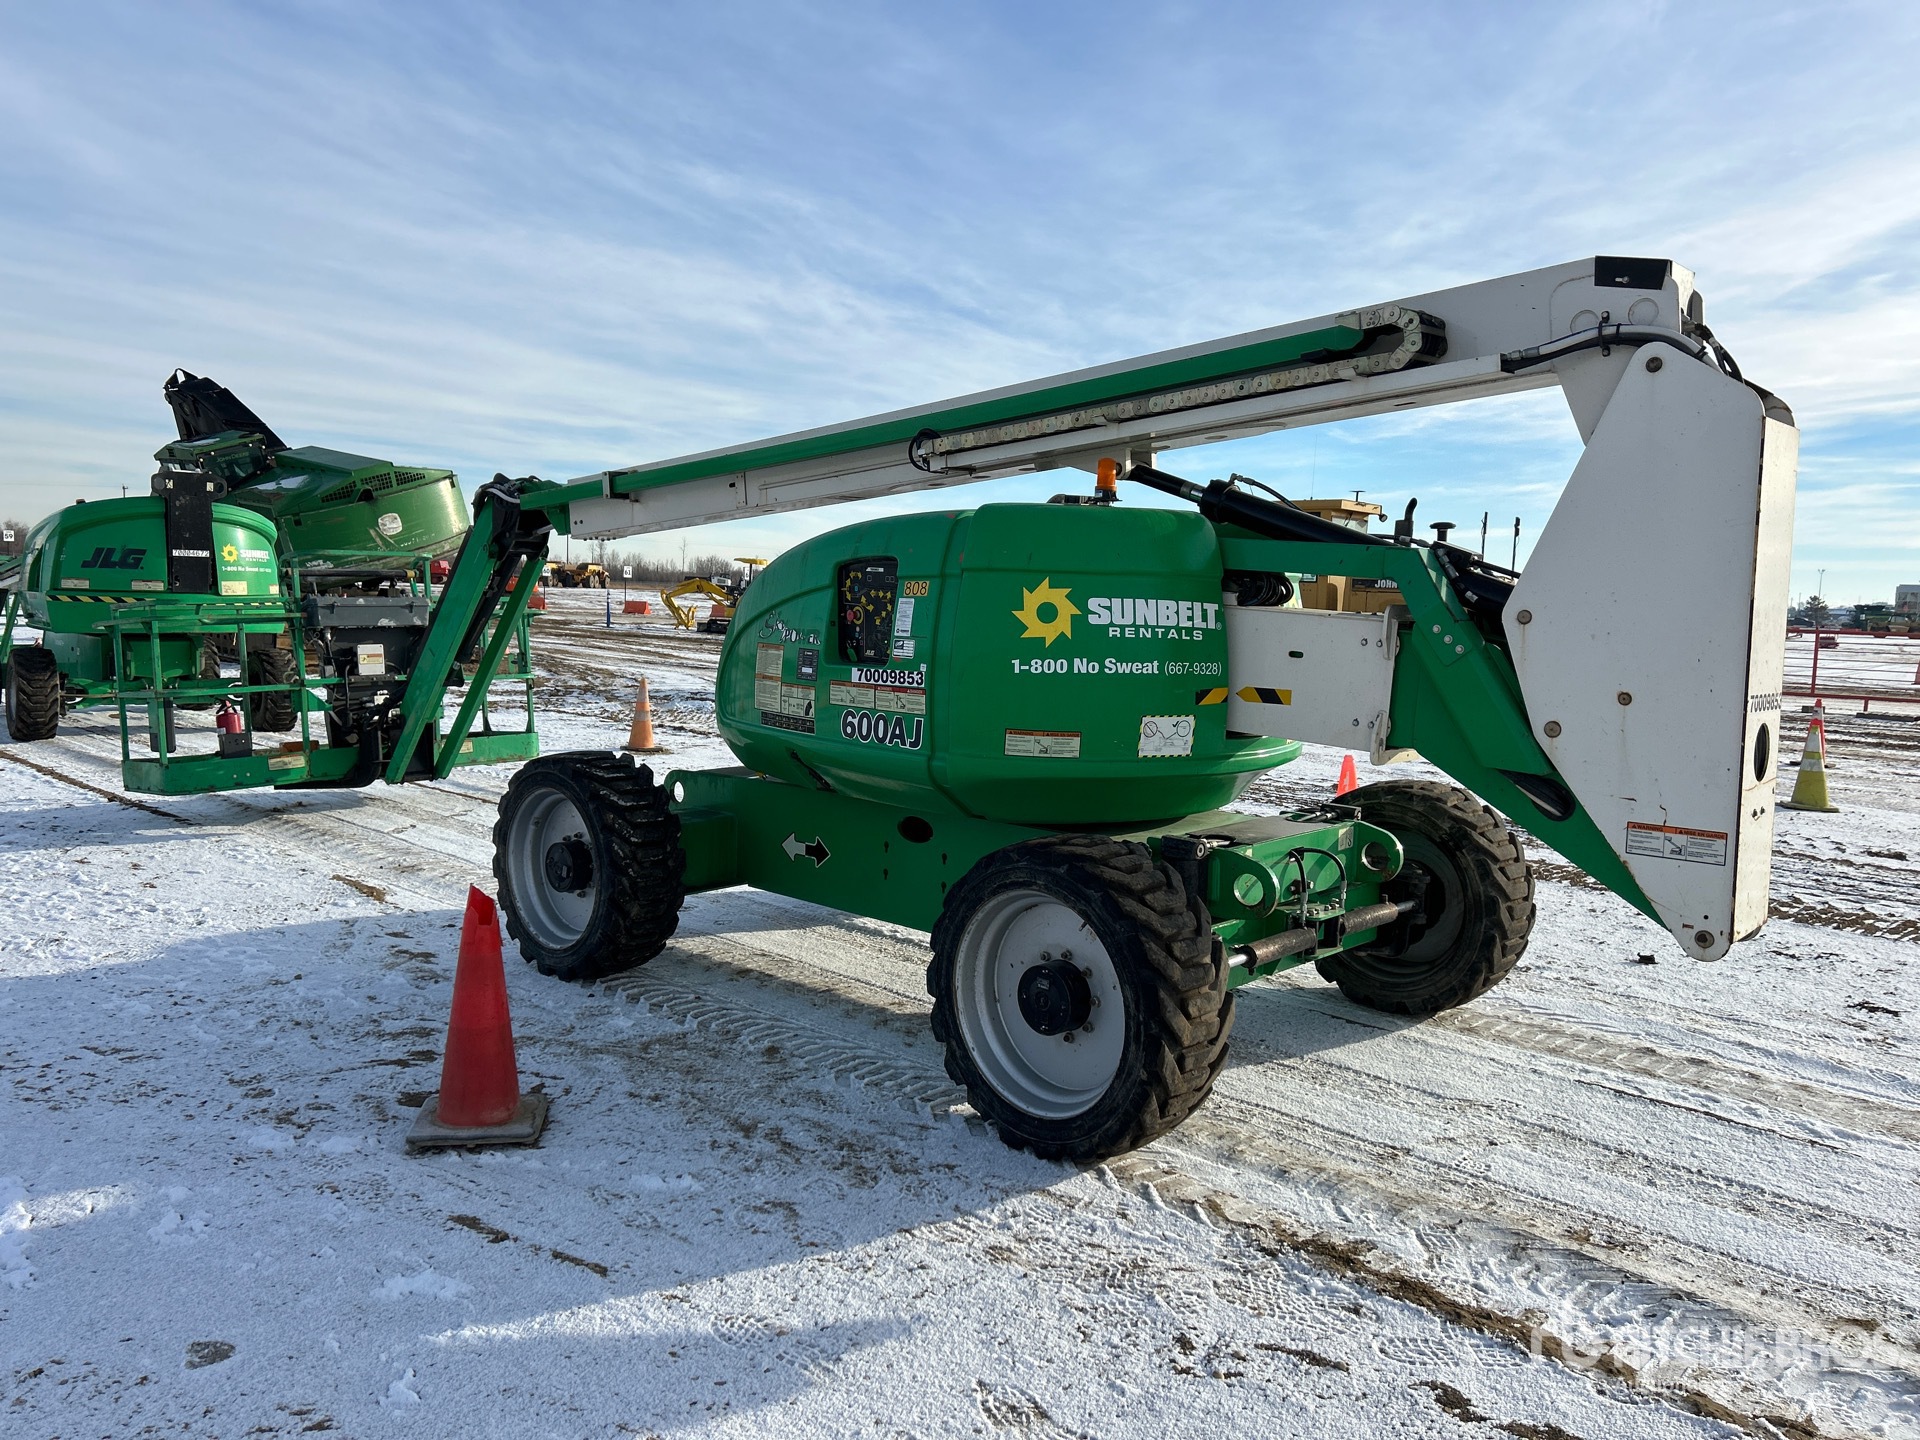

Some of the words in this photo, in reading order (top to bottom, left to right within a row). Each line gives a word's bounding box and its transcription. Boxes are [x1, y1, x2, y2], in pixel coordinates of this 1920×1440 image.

[81, 547, 147, 569] JLG
[904, 581, 928, 596] 808
[1087, 597, 1219, 630] SUNBELT
[1108, 627, 1203, 641] RENTALS
[856, 668, 924, 686] 70009853
[1011, 658, 1068, 674] 1-800
[1073, 658, 1100, 674] No
[1104, 658, 1159, 674] Sweat
[1164, 661, 1222, 677] (667-9328)
[840, 708, 924, 749] 600AJ
